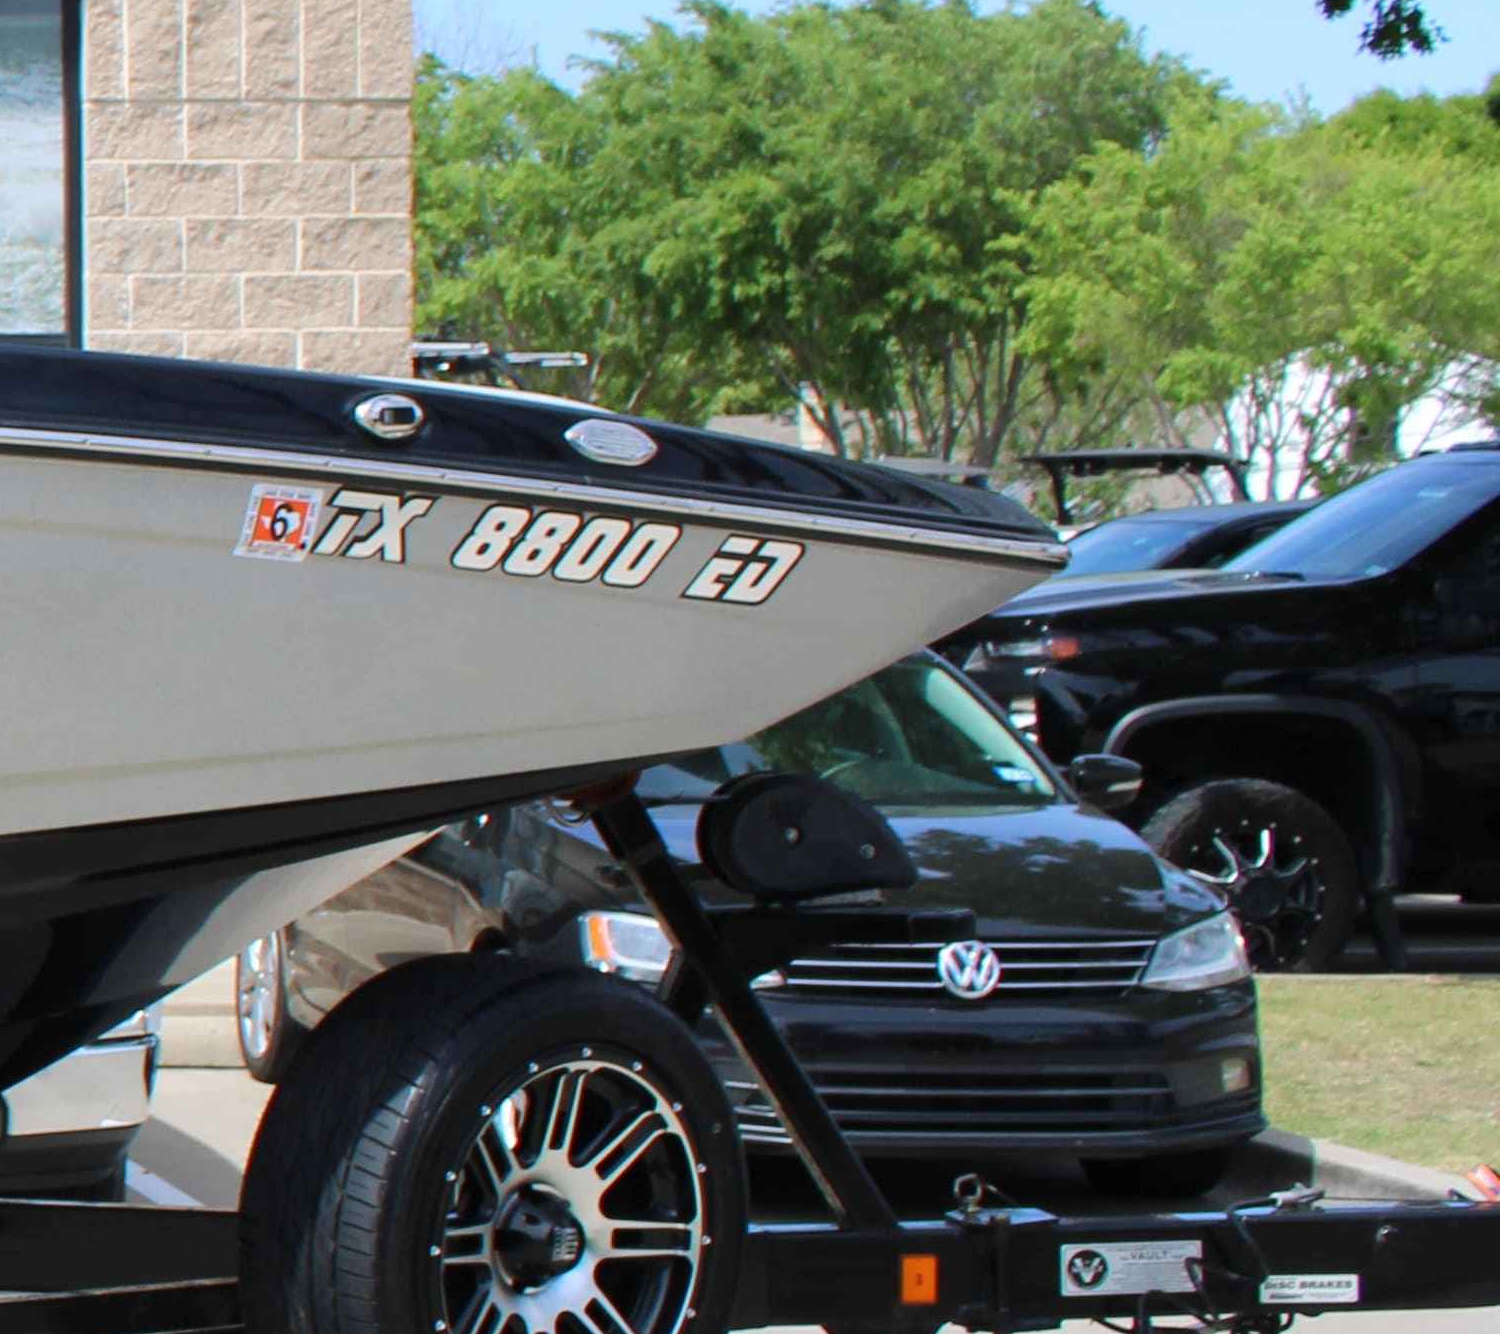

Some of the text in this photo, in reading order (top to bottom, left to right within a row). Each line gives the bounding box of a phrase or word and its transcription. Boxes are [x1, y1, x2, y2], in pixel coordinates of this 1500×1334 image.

[270, 502, 296, 541] 6
[311, 485, 441, 564] TX
[450, 502, 684, 589] 8800
[1299, 1279, 1353, 1290] BRAKES
